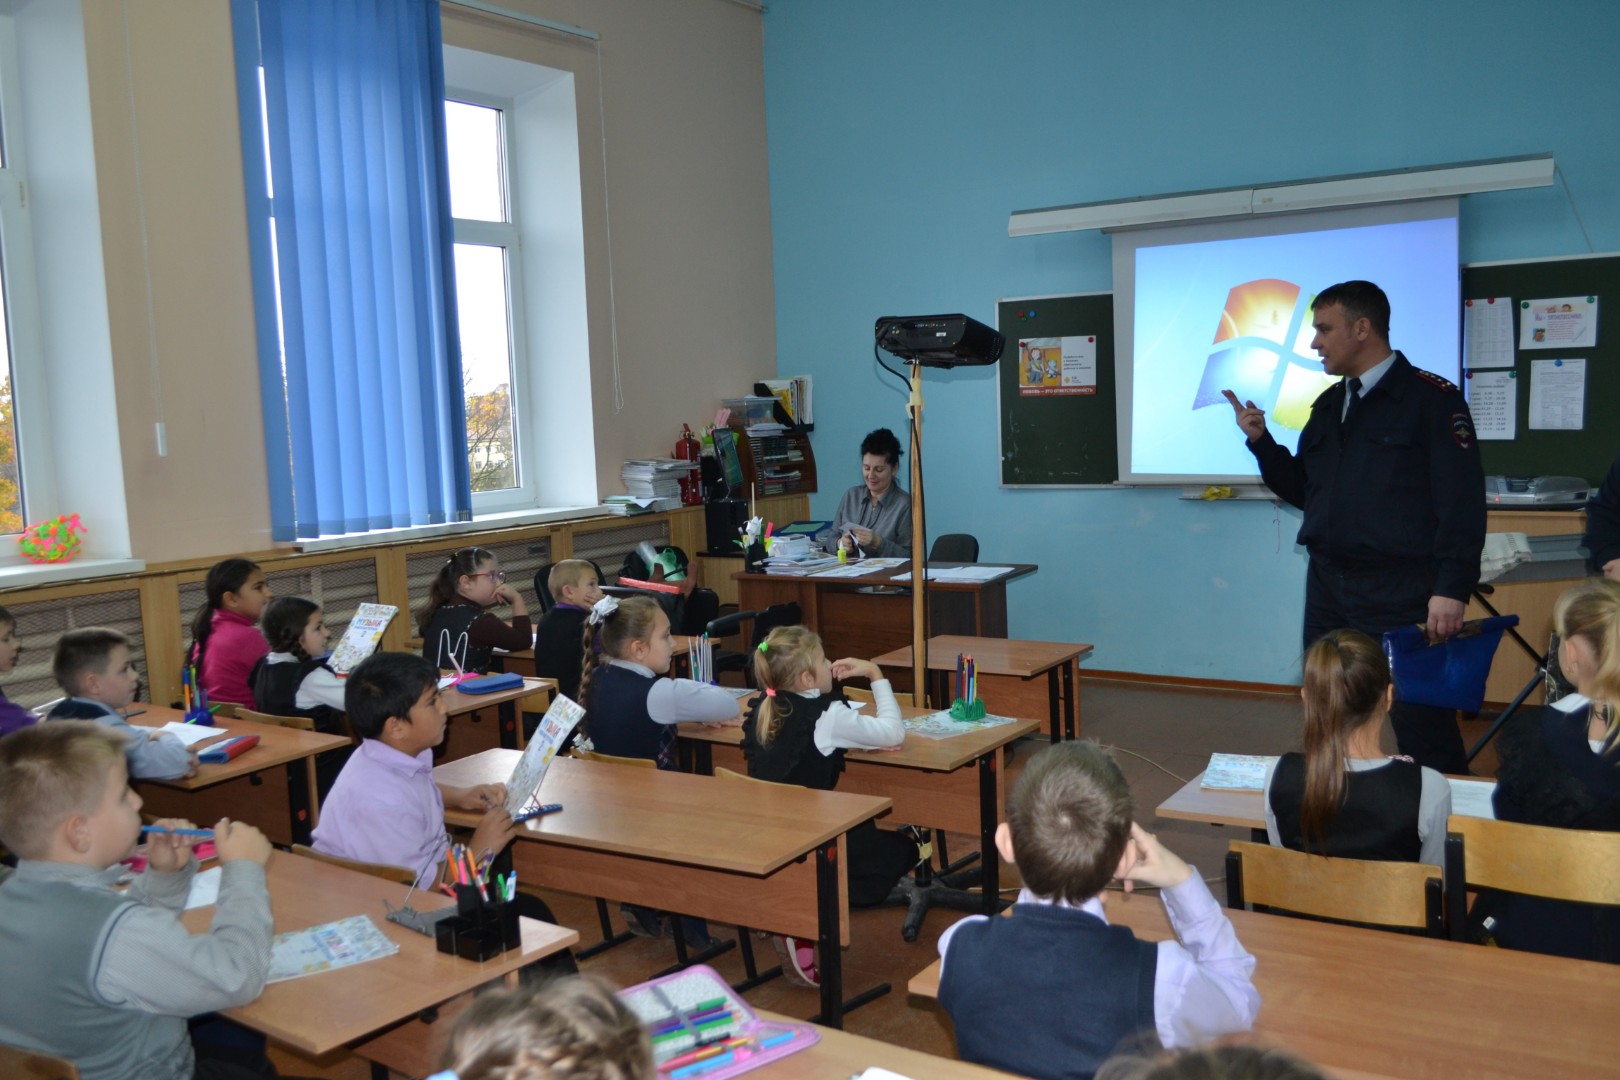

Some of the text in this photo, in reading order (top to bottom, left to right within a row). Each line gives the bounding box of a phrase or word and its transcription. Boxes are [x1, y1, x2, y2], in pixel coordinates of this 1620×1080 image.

[356, 618, 383, 627] МУЗЫКА
[360, 630, 367, 638] 2
[542, 718, 561, 738] МУЗЫКА
[538, 740, 545, 751] 2
